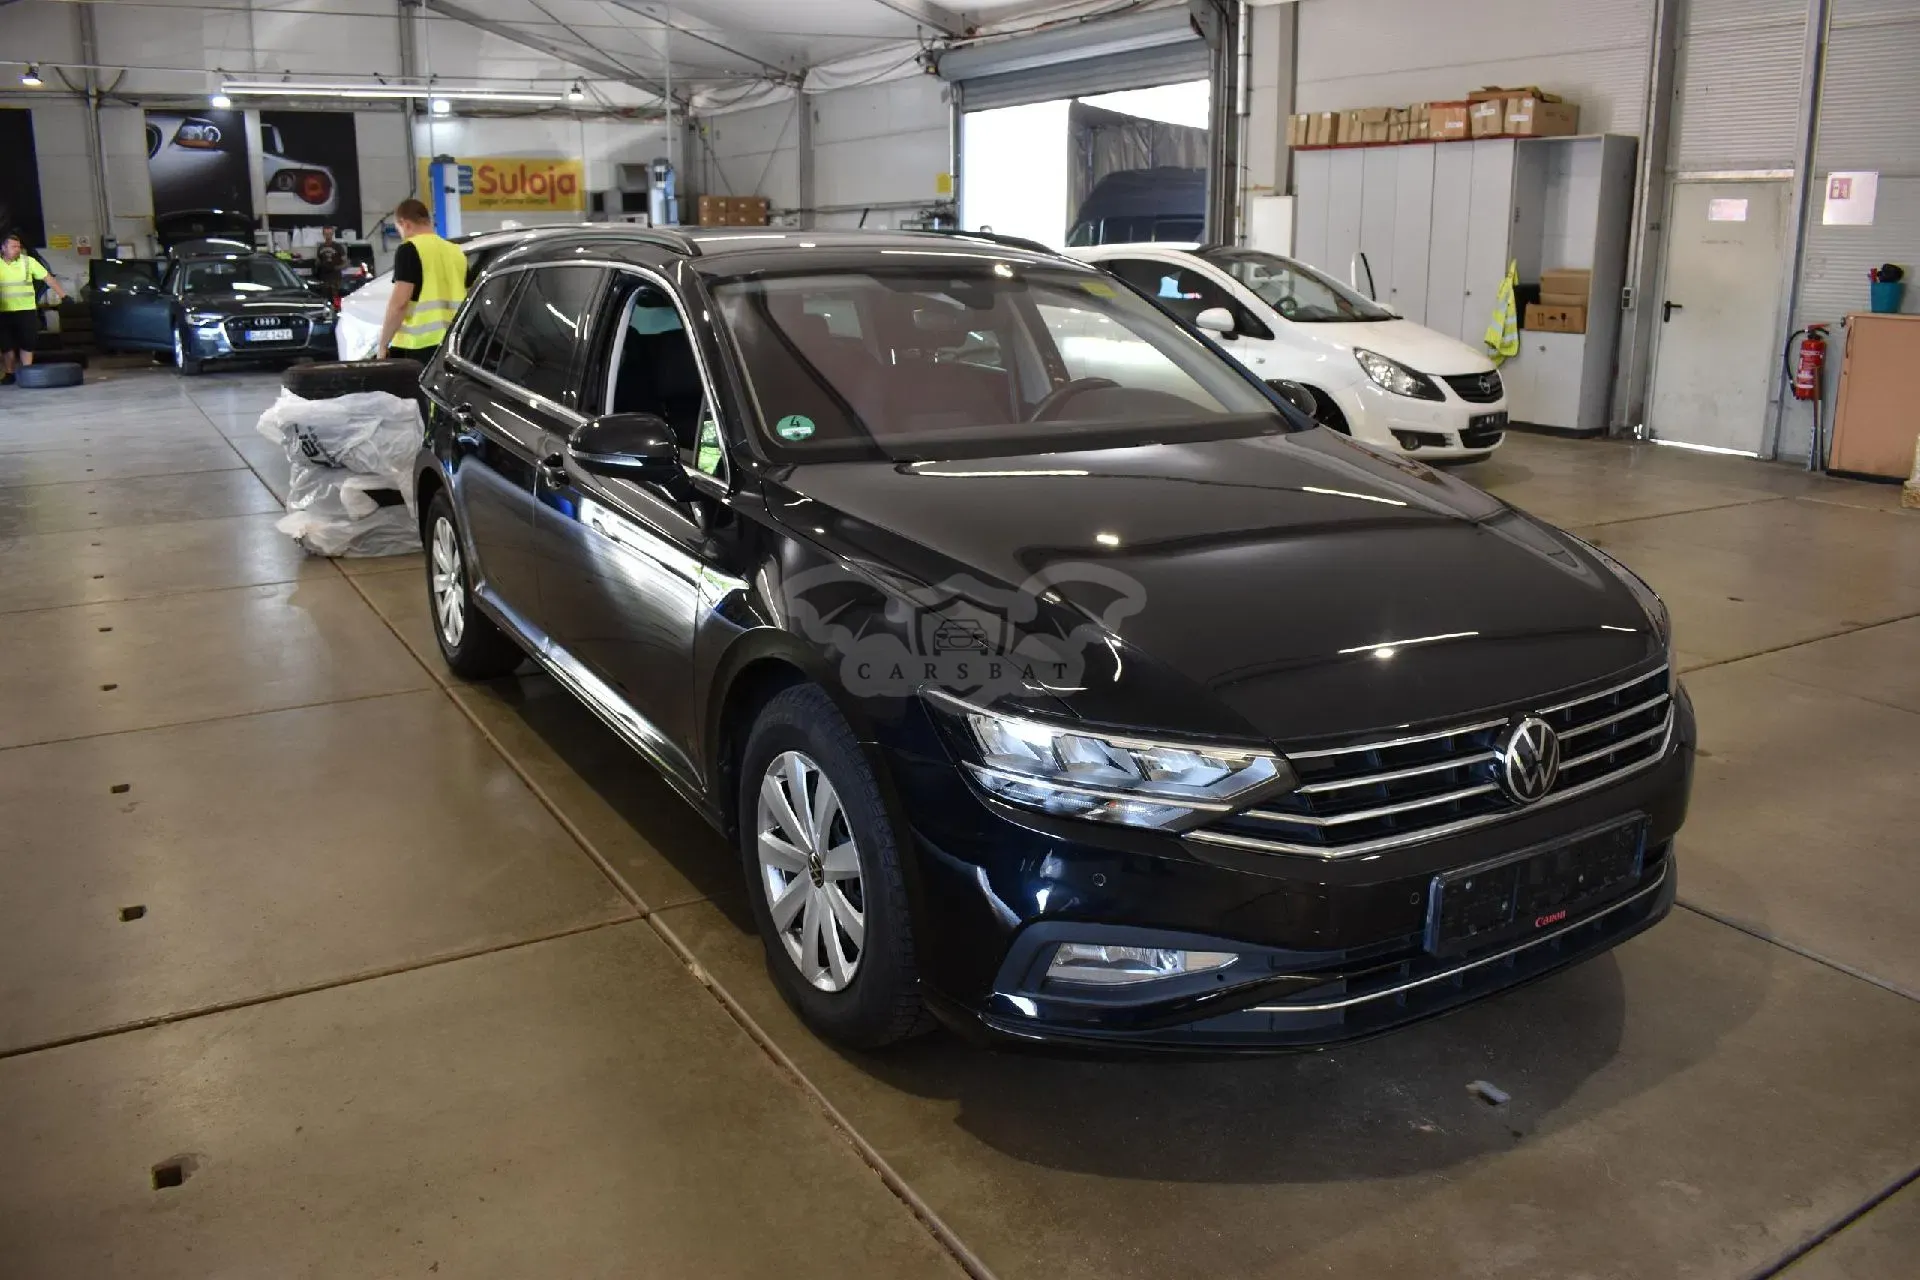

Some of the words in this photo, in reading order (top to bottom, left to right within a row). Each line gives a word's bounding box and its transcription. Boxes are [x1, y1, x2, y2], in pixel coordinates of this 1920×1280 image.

[478, 164, 576, 204] Suloja
[789, 416, 800, 427] 4
[1535, 910, 1566, 928] Canon
